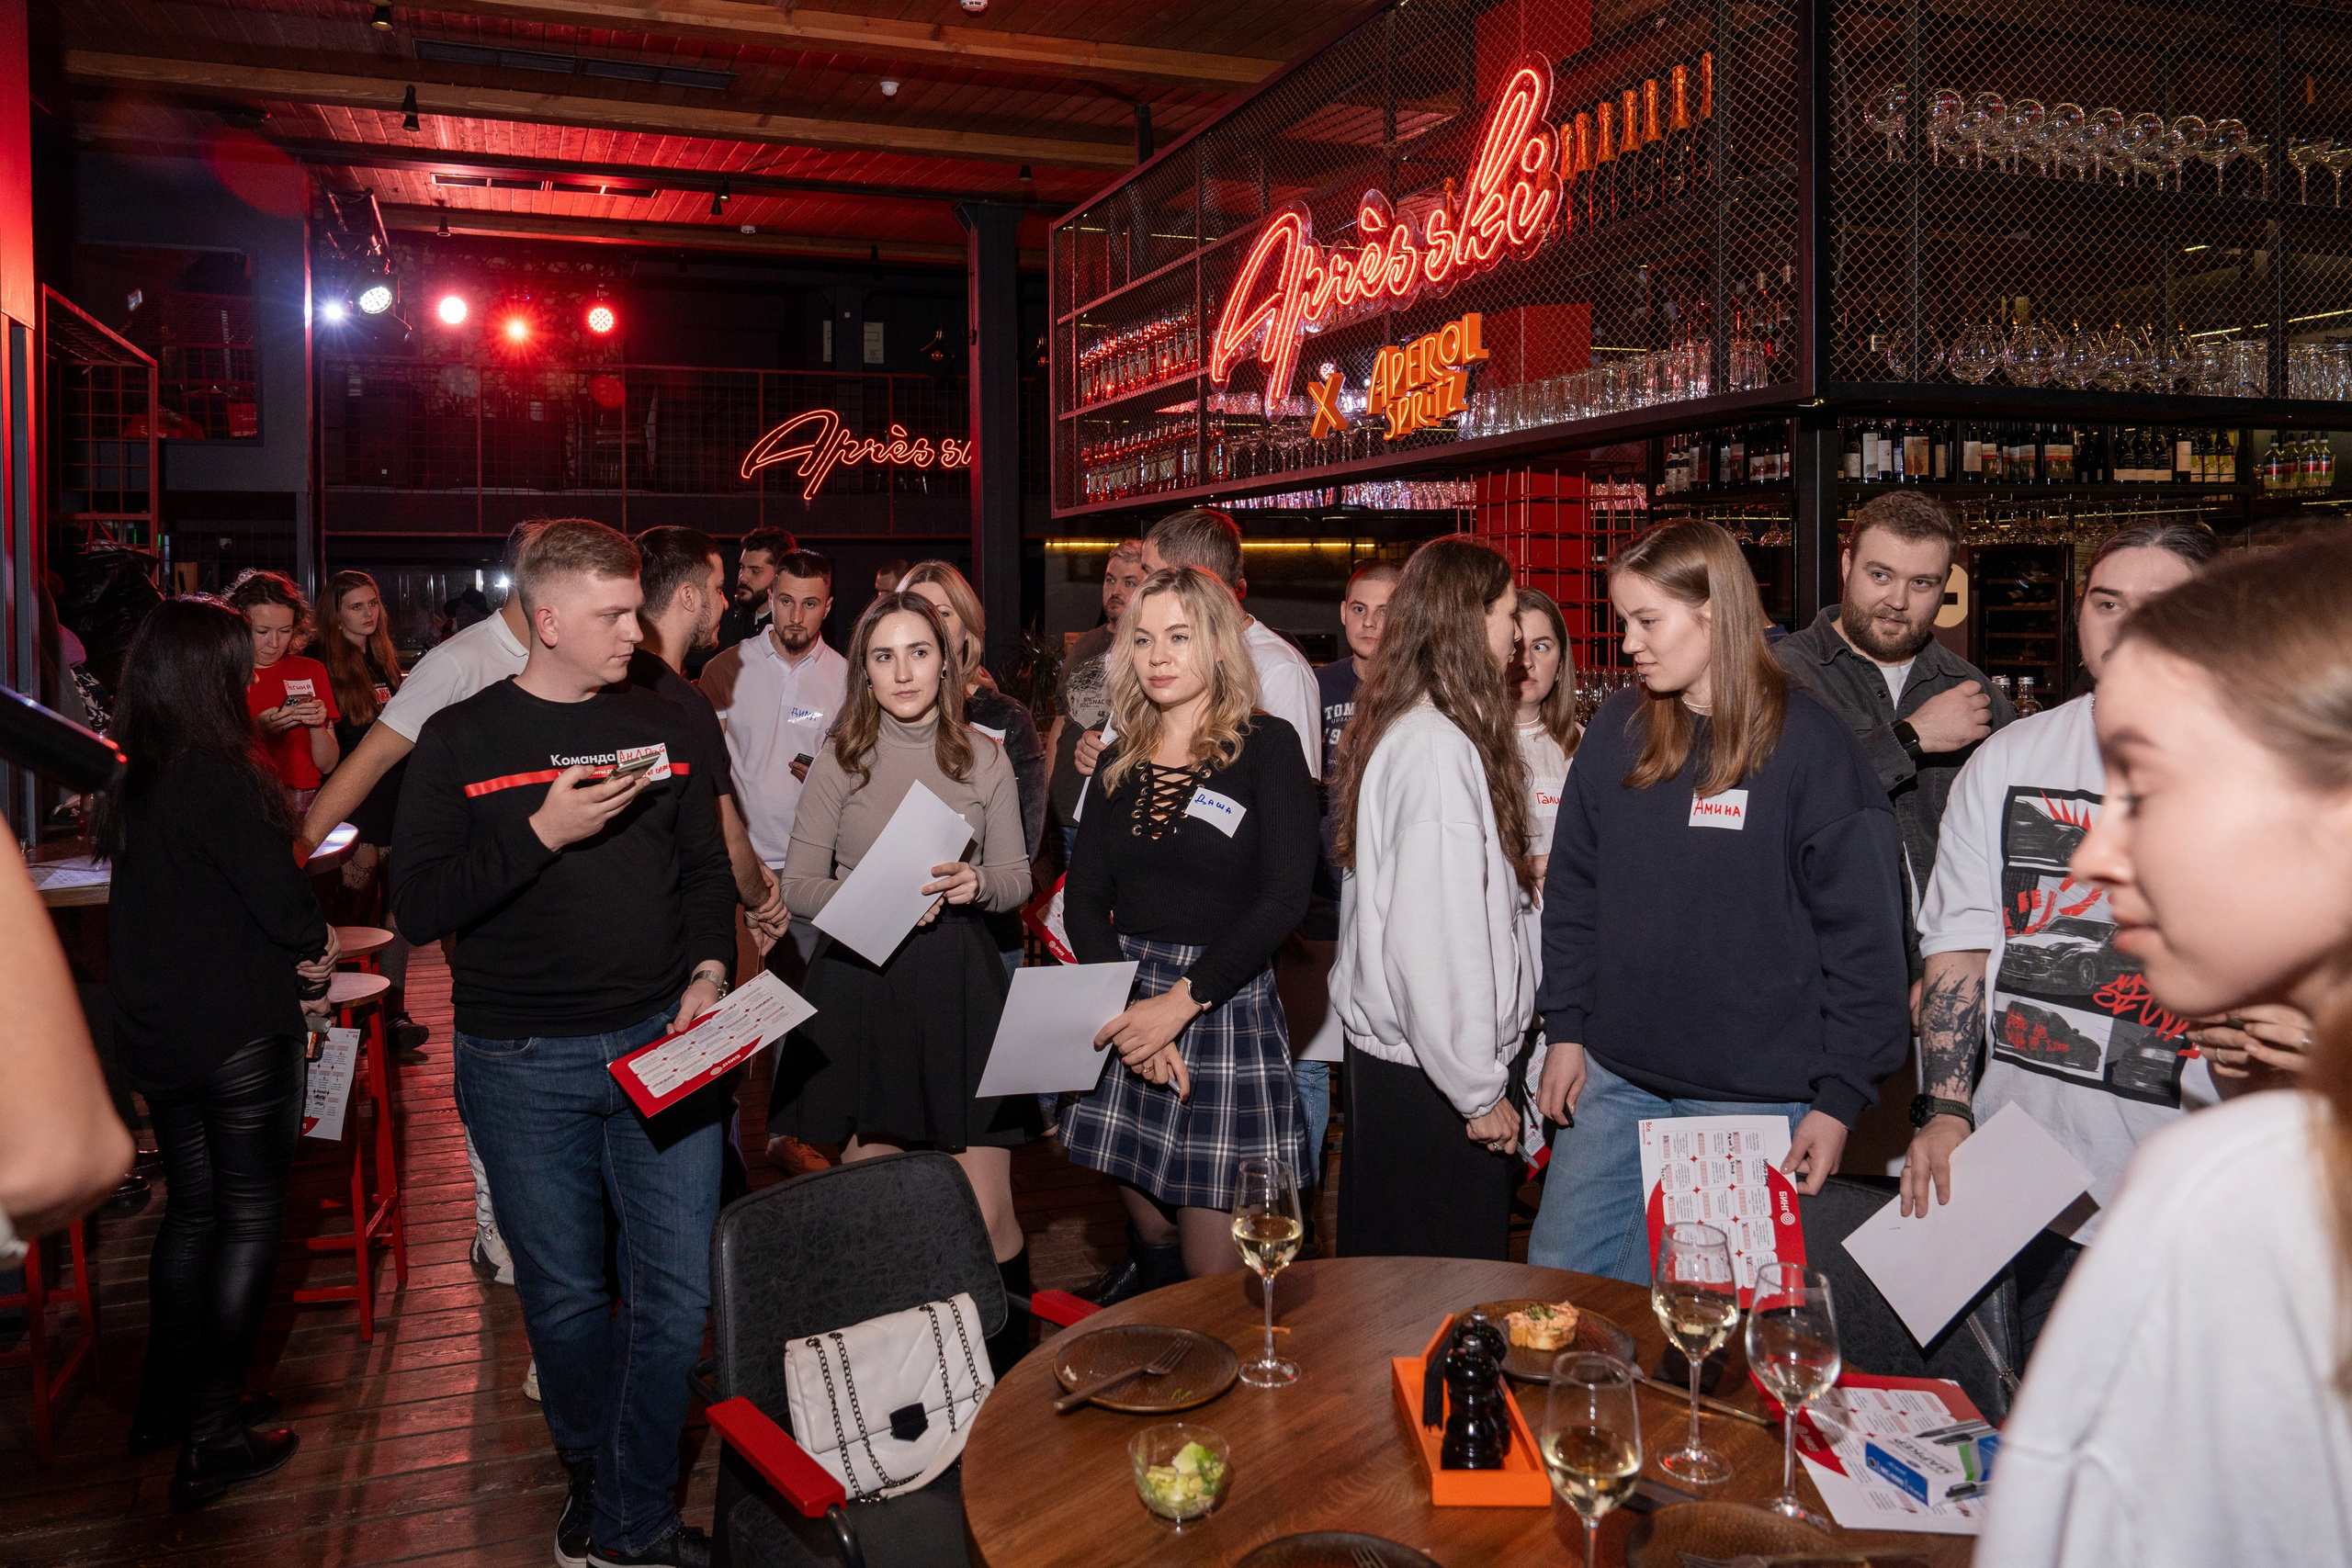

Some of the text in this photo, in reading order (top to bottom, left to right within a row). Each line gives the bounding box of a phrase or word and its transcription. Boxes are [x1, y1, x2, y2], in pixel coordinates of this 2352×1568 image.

[1210, 68, 1551, 412] Après ski
[1366, 311, 1489, 416] APEROL
[741, 409, 935, 501] Après
[550, 753, 616, 767] Команда
